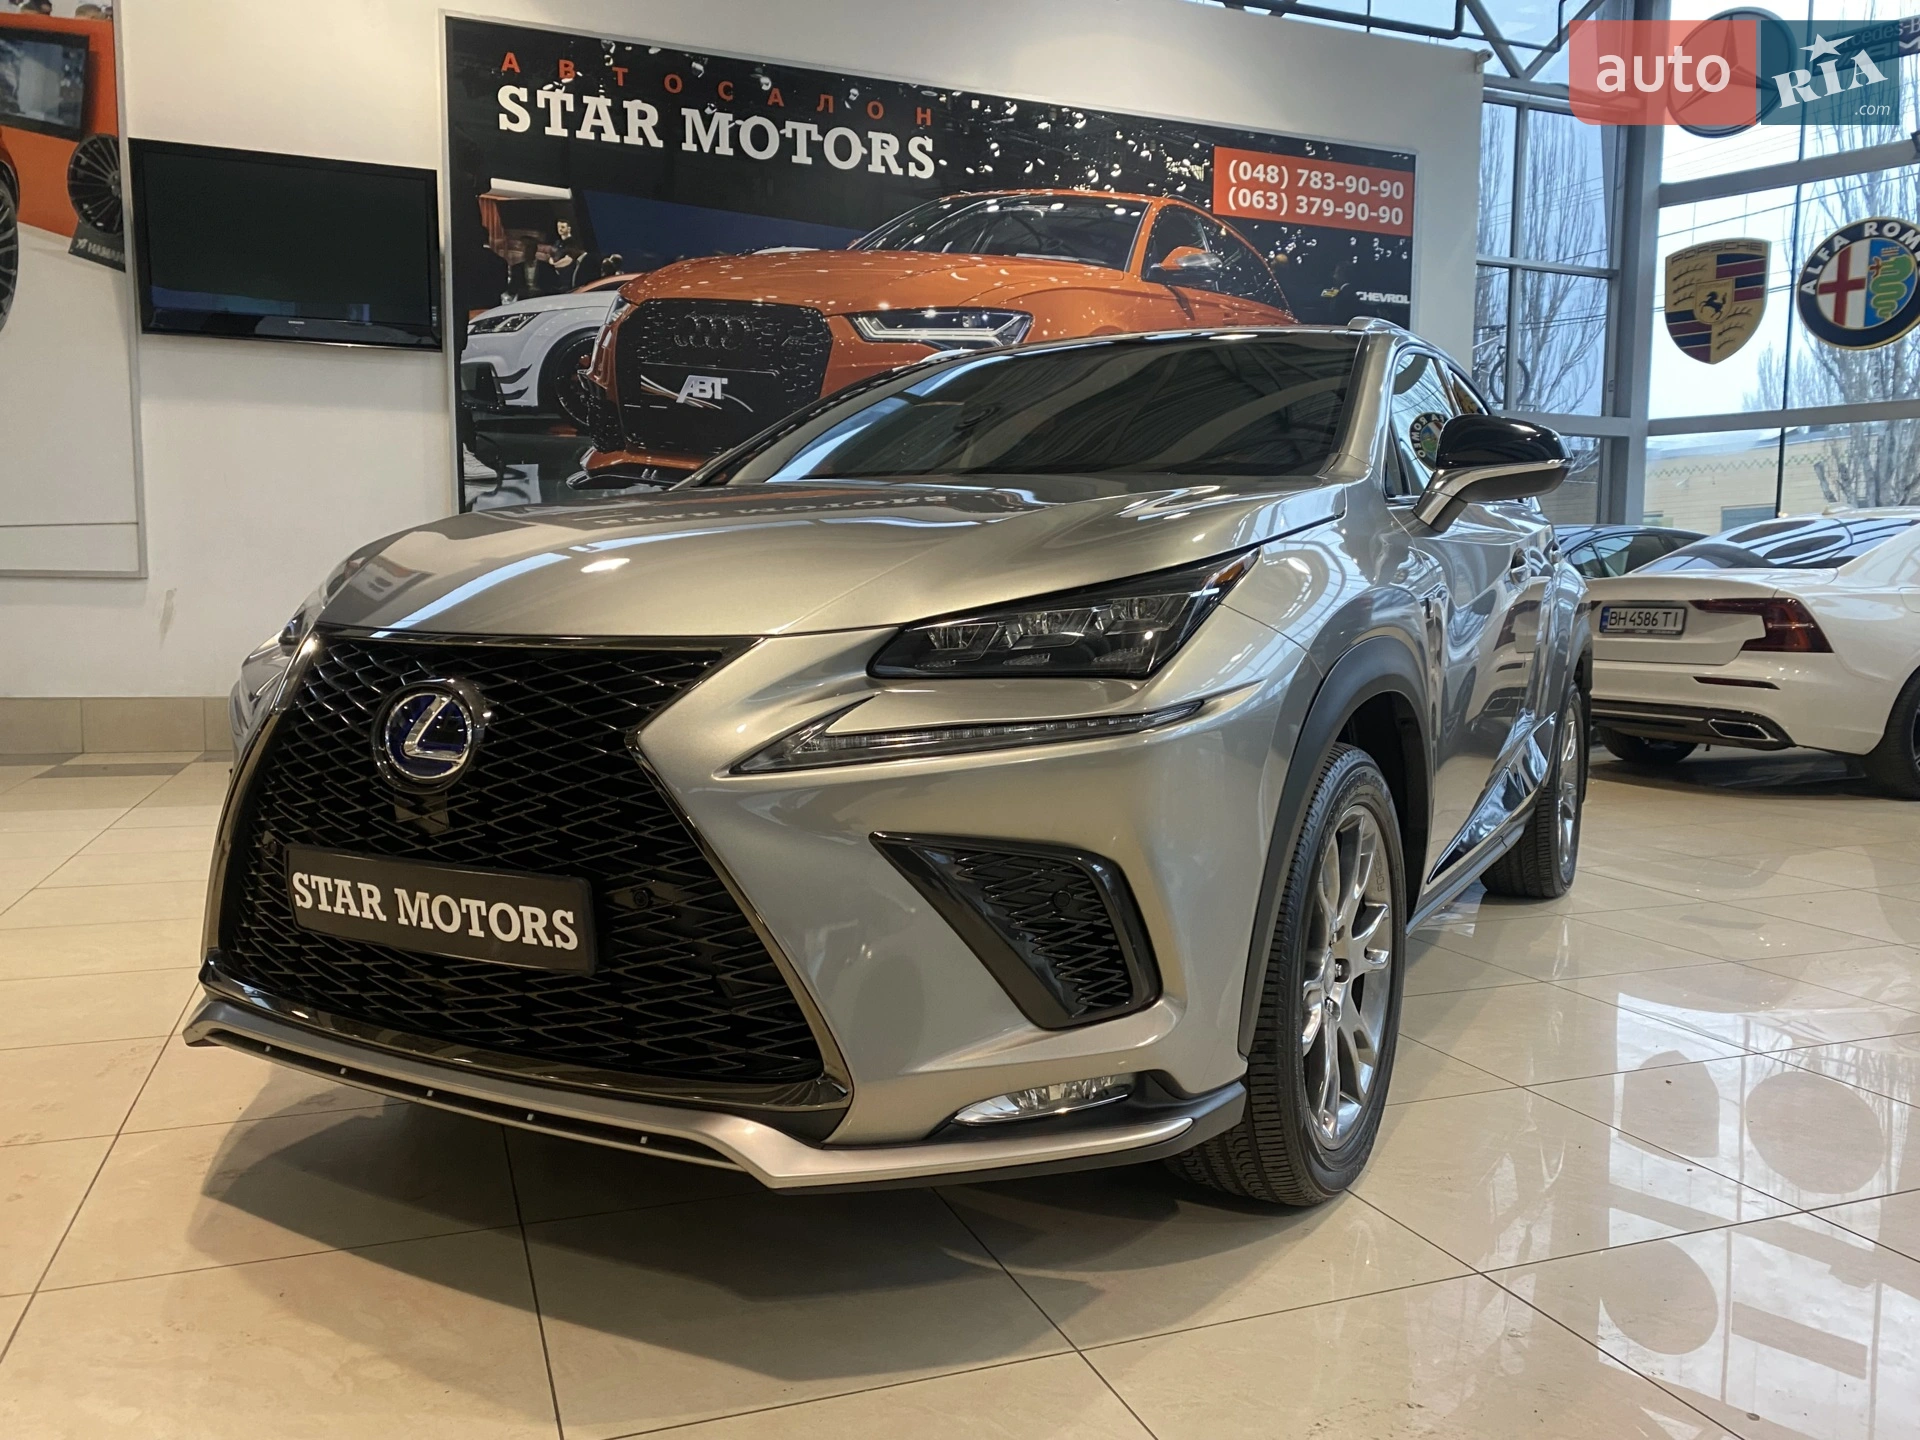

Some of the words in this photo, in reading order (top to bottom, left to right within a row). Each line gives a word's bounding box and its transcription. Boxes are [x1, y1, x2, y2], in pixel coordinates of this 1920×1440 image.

[501, 51, 932, 126] АВТОСАЛОН
[498, 85, 663, 148] STAR
[681, 106, 935, 179] MOTORS
[1228, 160, 1289, 189] (048)
[1297, 169, 1405, 200] 783-90-90
[1228, 187, 1288, 216] (063)
[1295, 198, 1404, 226] 379-90-90
[1671, 241, 1762, 264] PORSCHE
[1801, 235, 1851, 295] ALFA
[676, 374, 728, 404] ABT
[292, 871, 387, 922] STAR
[394, 887, 579, 951] MOTORS
